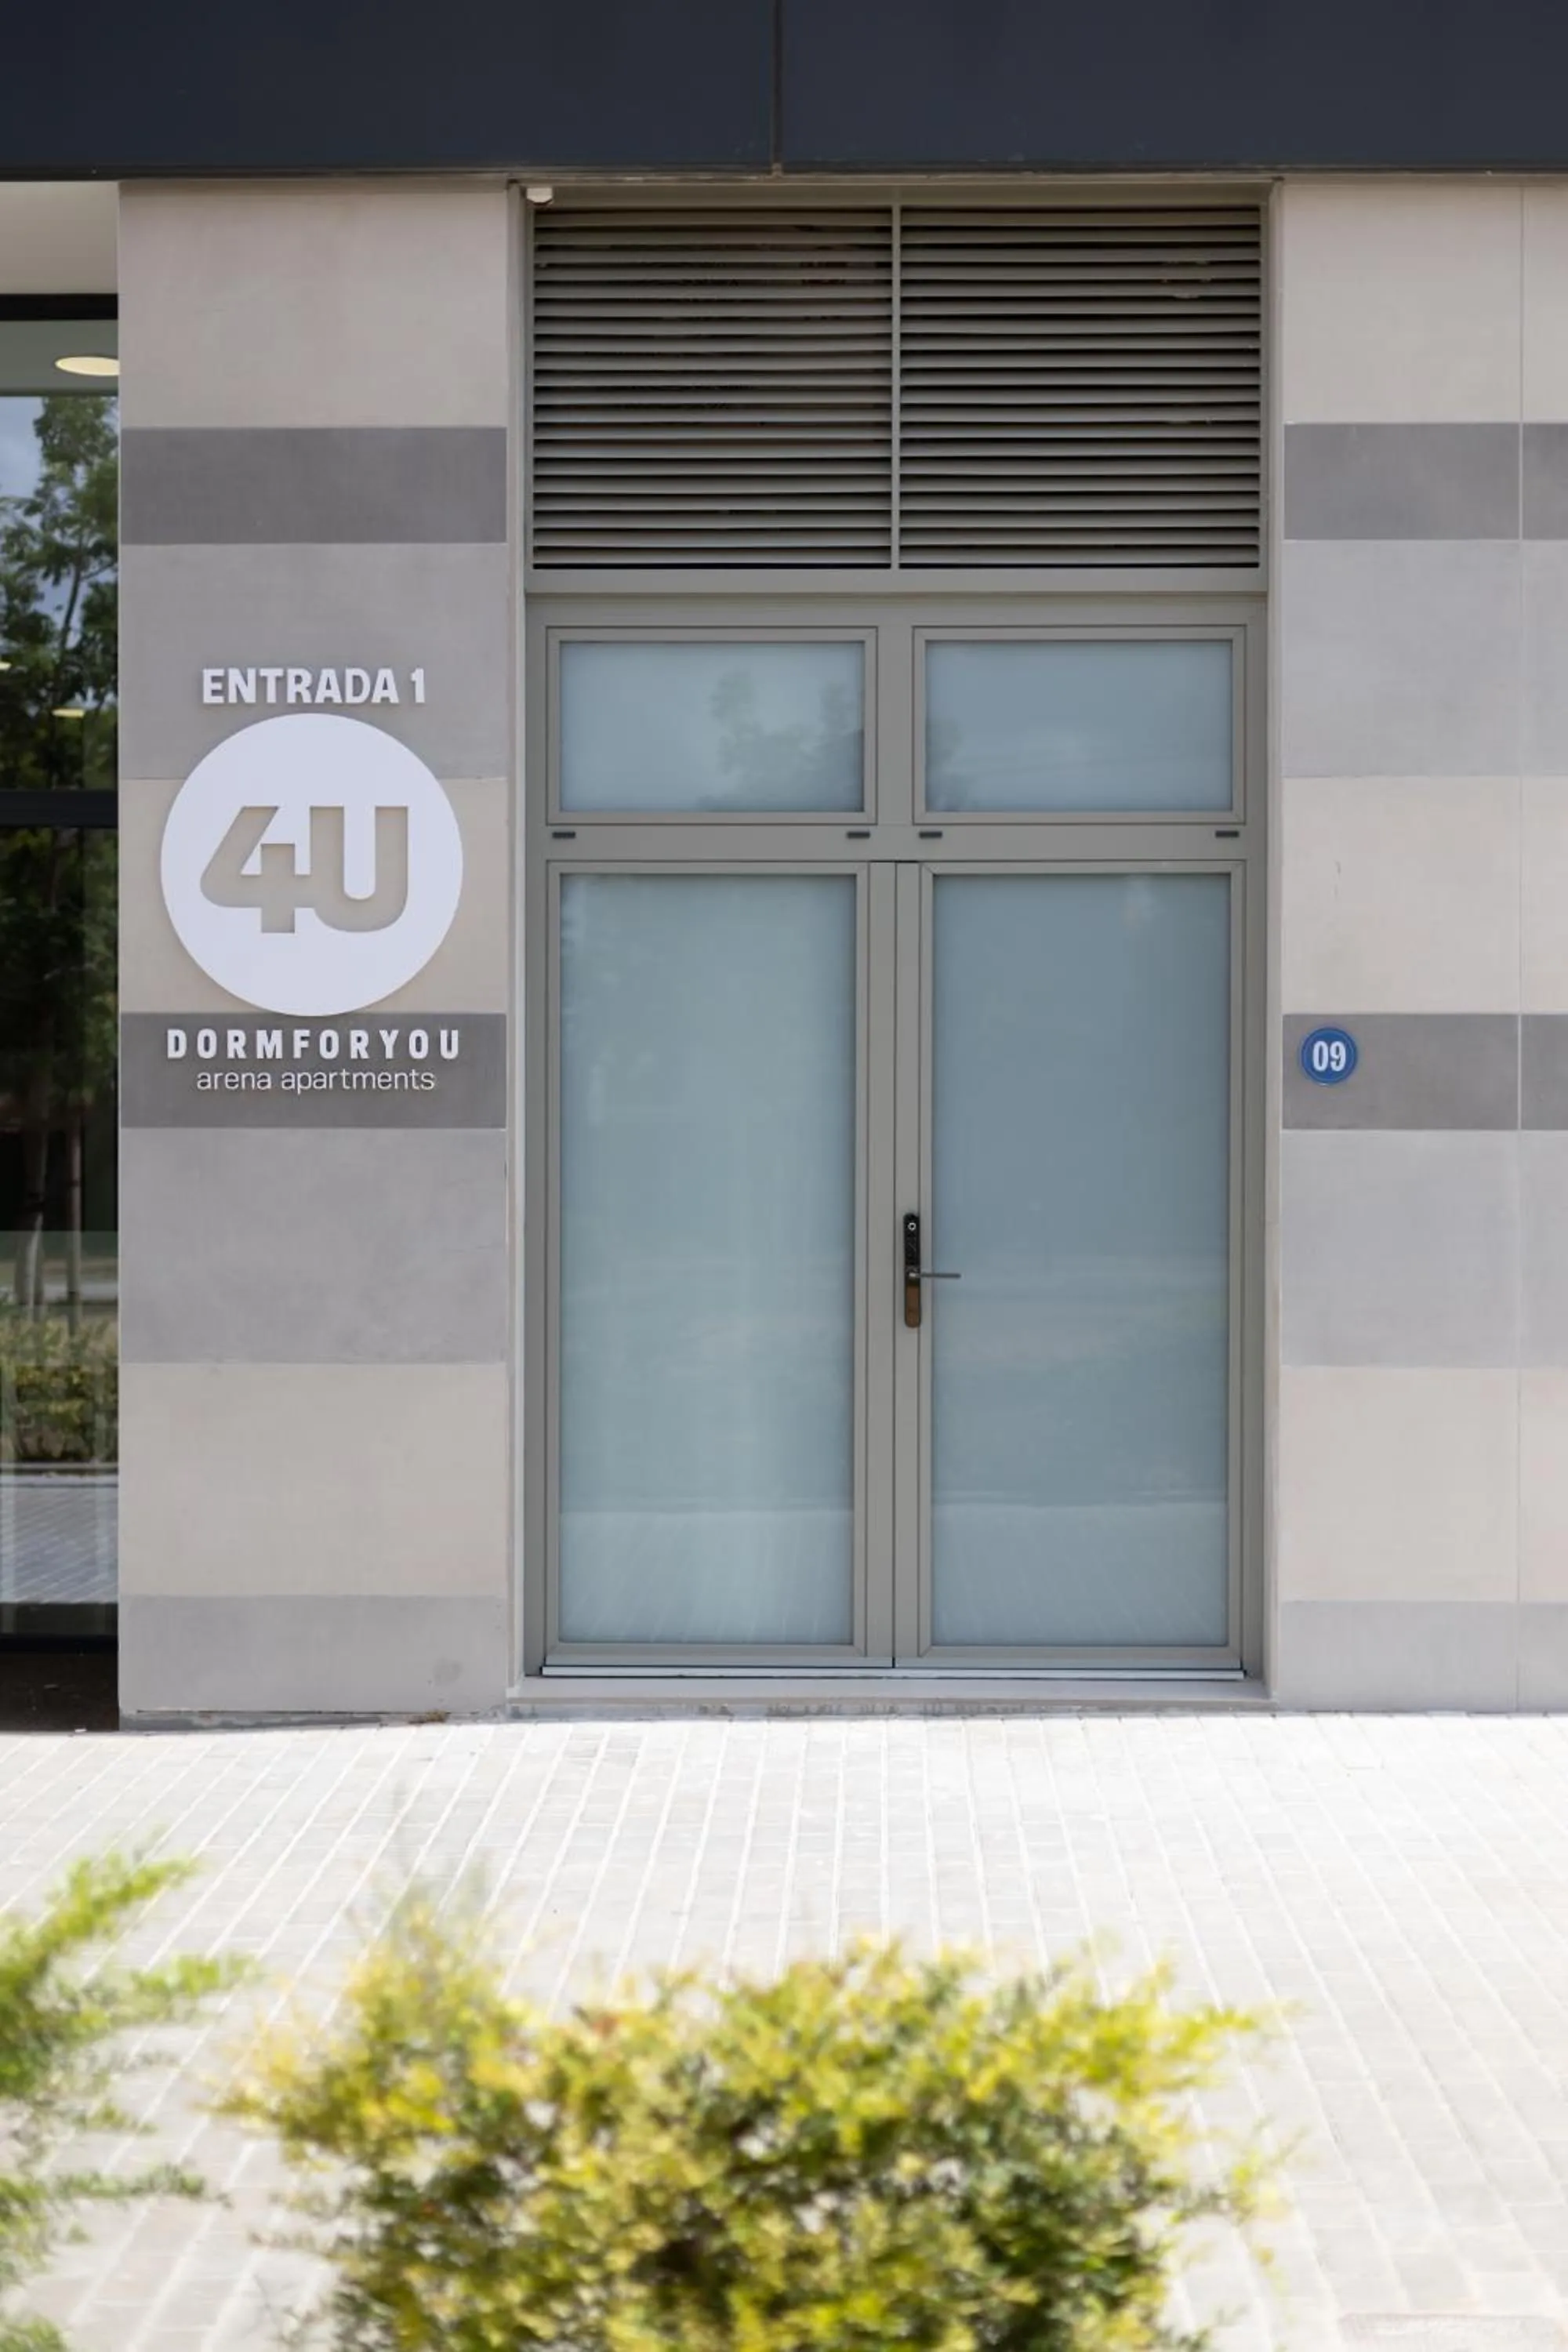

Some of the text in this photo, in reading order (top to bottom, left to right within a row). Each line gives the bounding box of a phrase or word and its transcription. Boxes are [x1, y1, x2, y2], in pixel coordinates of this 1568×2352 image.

[201, 668, 426, 704] ENTRADA 1
[200, 805, 409, 934] 4U
[166, 1029, 460, 1060] DORMFORYOU
[1312, 1040, 1346, 1072] 09
[196, 1069, 435, 1094] arena apartments
